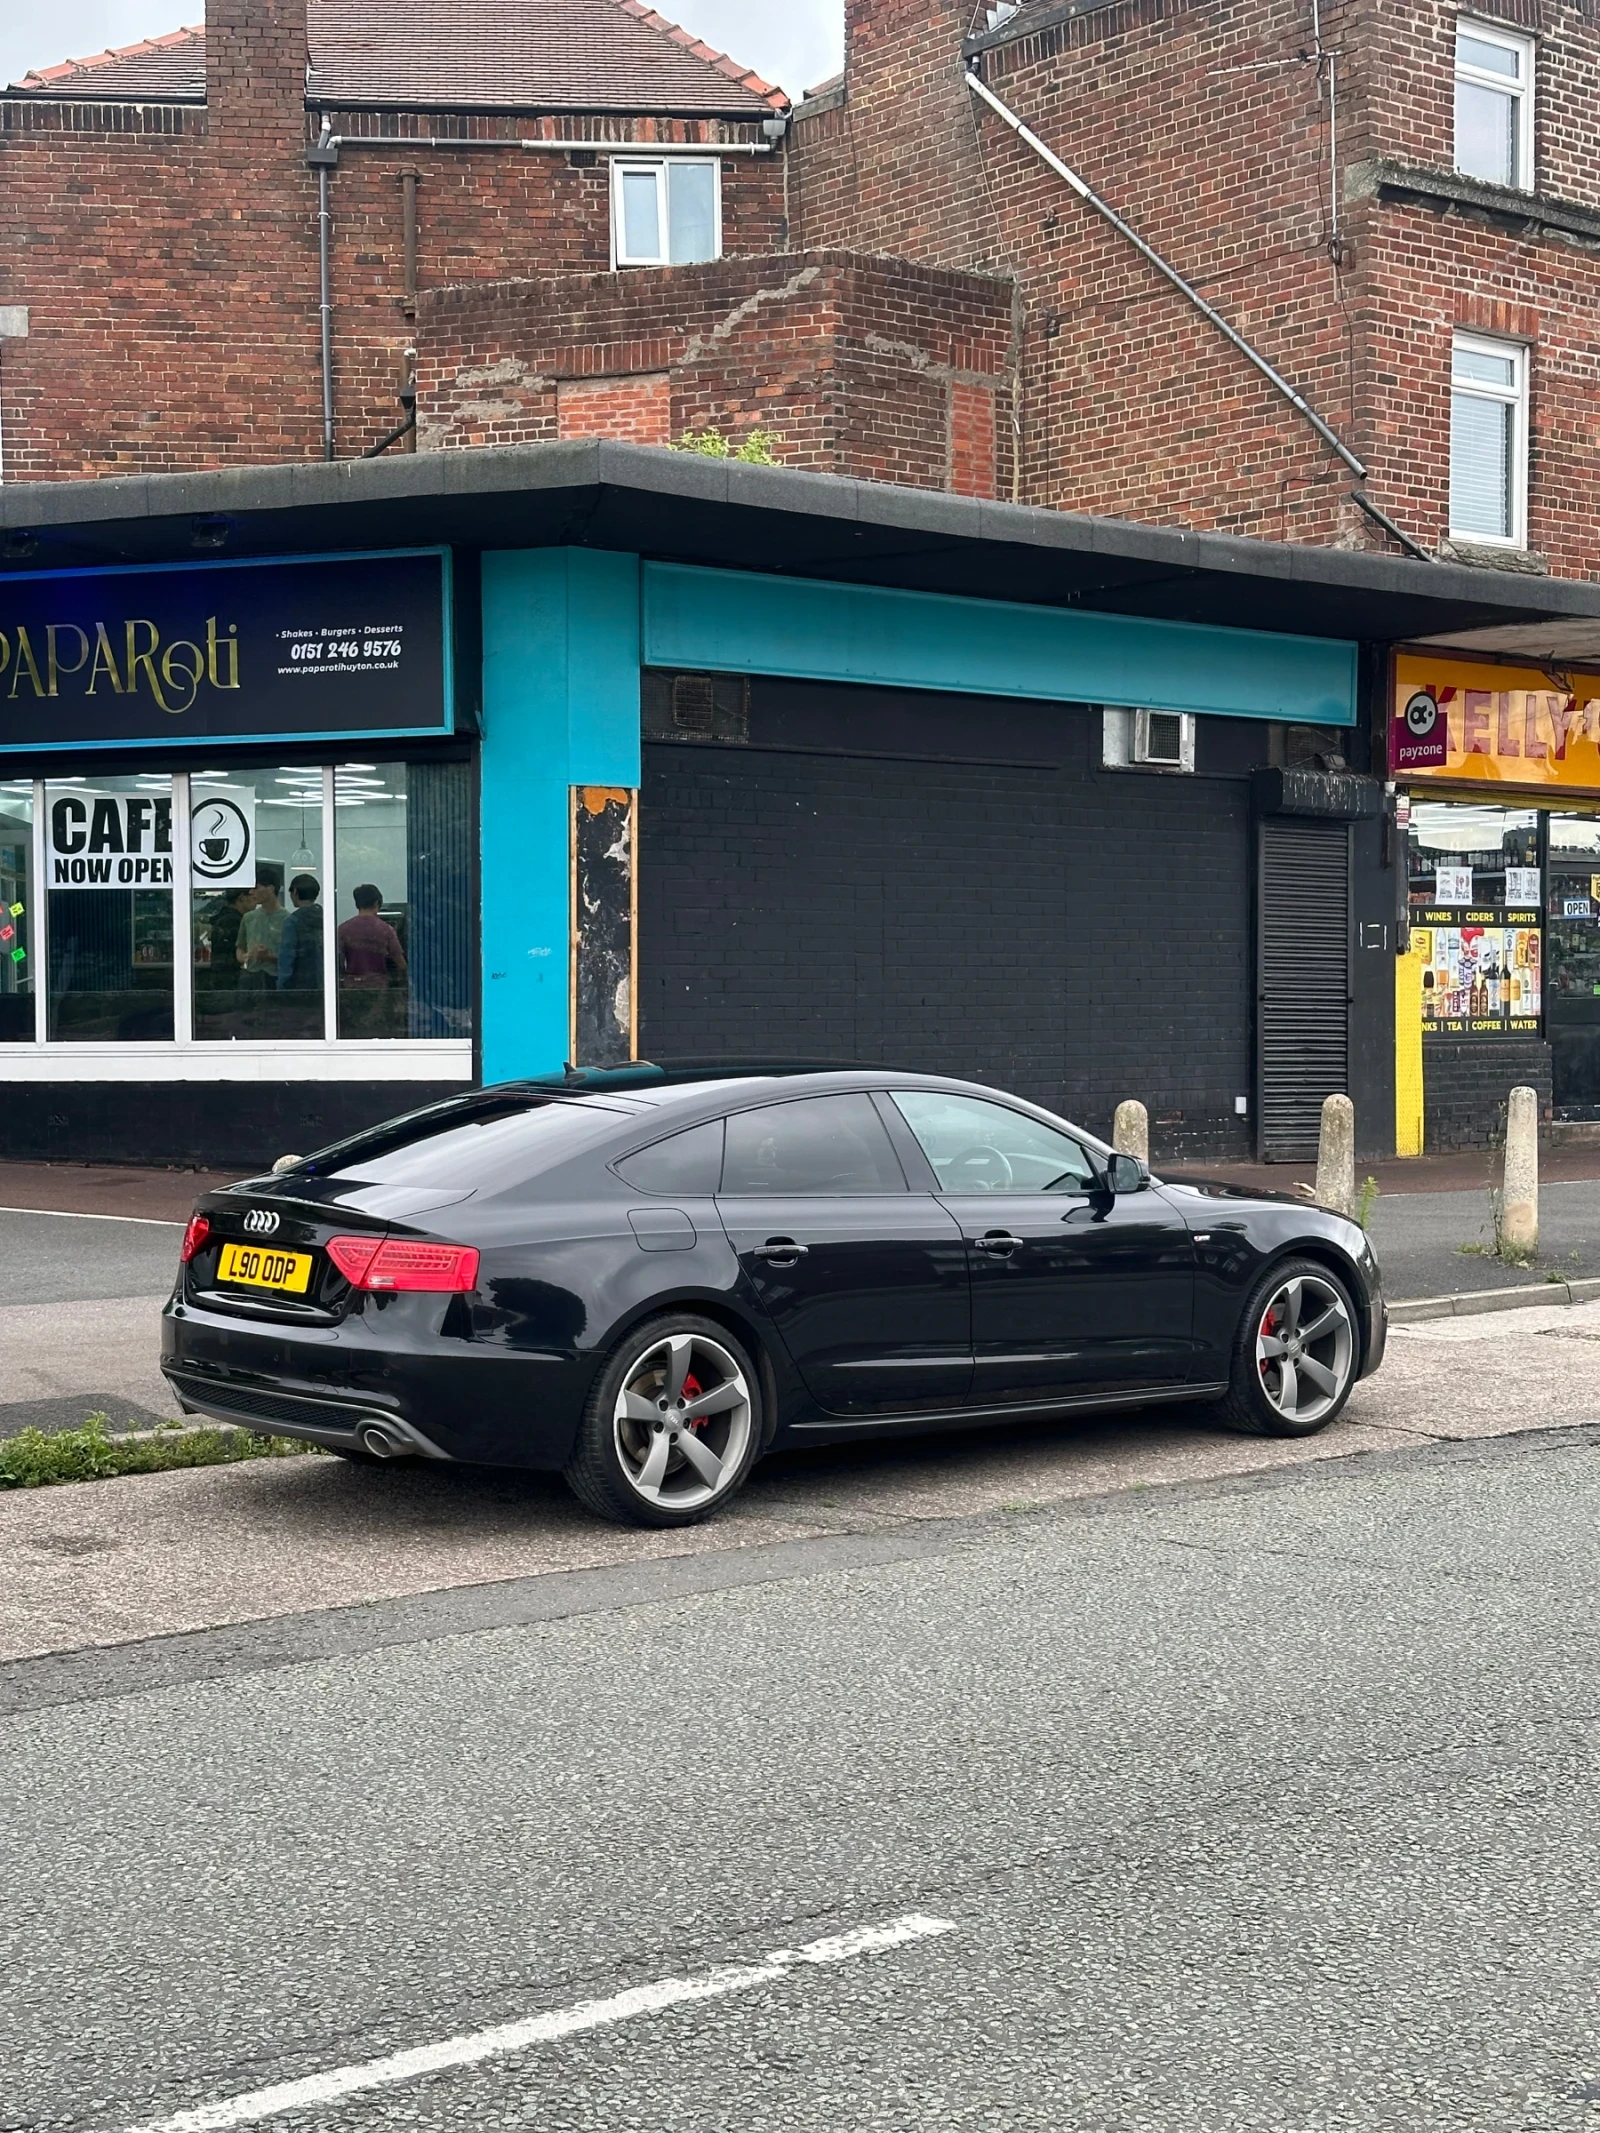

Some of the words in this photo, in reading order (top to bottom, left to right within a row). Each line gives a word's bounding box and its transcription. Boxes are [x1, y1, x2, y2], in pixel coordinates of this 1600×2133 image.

[281, 629, 313, 638] Shakes
[321, 628, 356, 637] Burgers
[364, 625, 403, 634] Desserts
[290, 642, 323, 660] 0151
[327, 641, 359, 658] 246
[363, 639, 402, 657] 9576
[0, 616, 240, 713] APARoti
[277, 660, 399, 675] www.paparotihuyton.co.uk
[1400, 743, 1443, 761] payzone
[52, 797, 173, 854] CAFE
[54, 858, 113, 883] NOW
[118, 858, 173, 883] OPEN
[1425, 911, 1452, 921] WINES
[1466, 912, 1494, 922] CIDERS
[1507, 912, 1536, 922] SPIRITS
[1567, 902, 1589, 915] OPEN
[1421, 1021, 1437, 1031] NKS
[1447, 1021, 1462, 1031] TEA
[1472, 1020, 1501, 1030] COFFEE
[1510, 1020, 1537, 1030] WATER
[229, 1250, 260, 1279] L90
